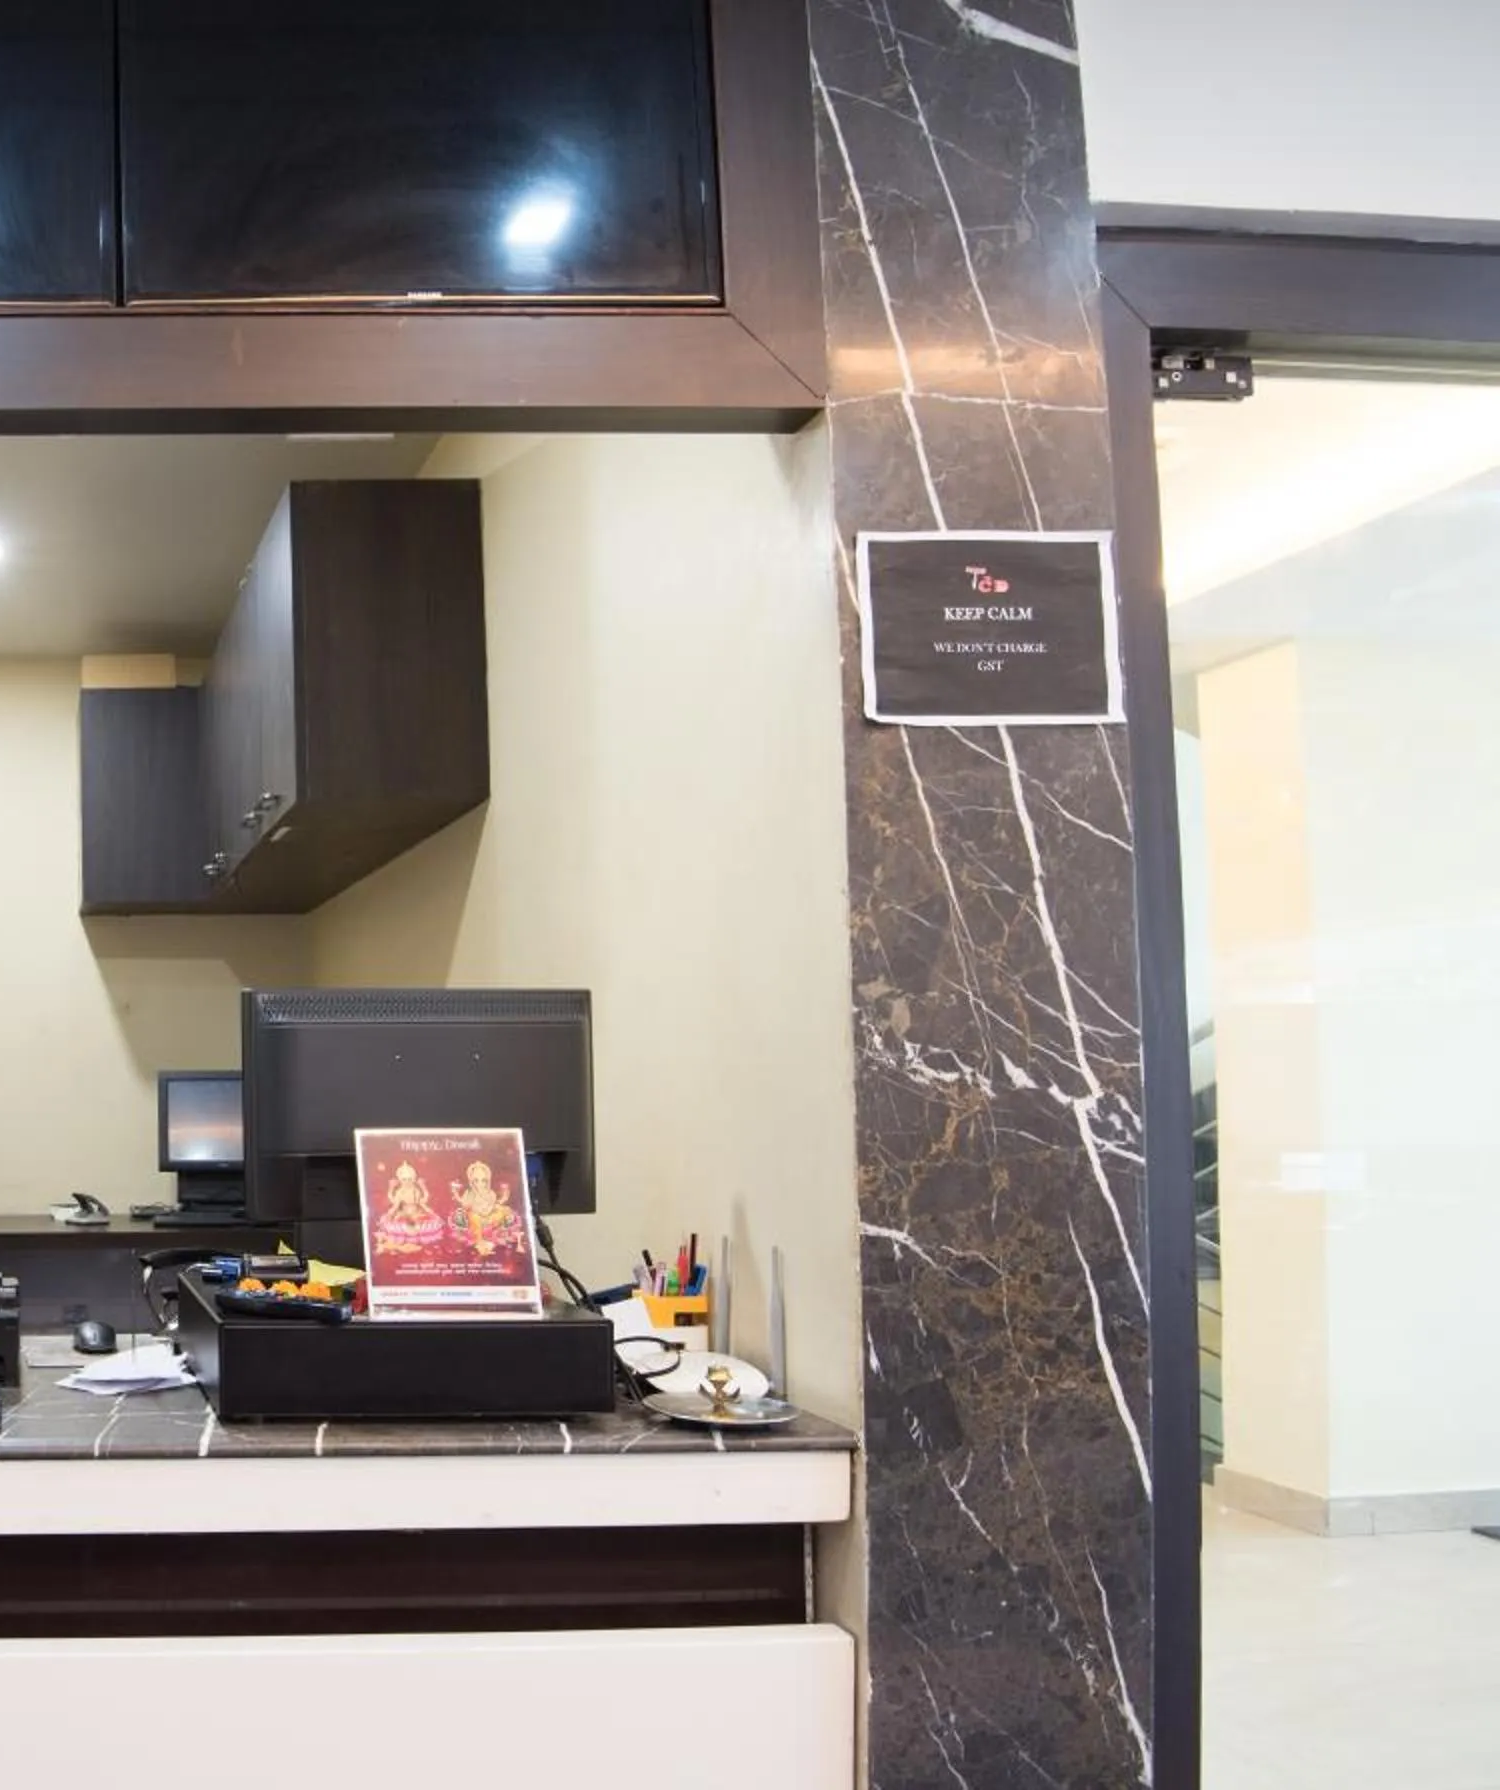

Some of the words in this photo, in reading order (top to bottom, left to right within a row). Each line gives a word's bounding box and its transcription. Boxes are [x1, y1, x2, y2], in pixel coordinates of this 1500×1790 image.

[944, 607, 985, 620] KEEP
[987, 607, 1033, 620] CALM
[933, 642, 955, 653] WE
[997, 642, 1048, 653] CHARGE
[977, 660, 1004, 671] GST
